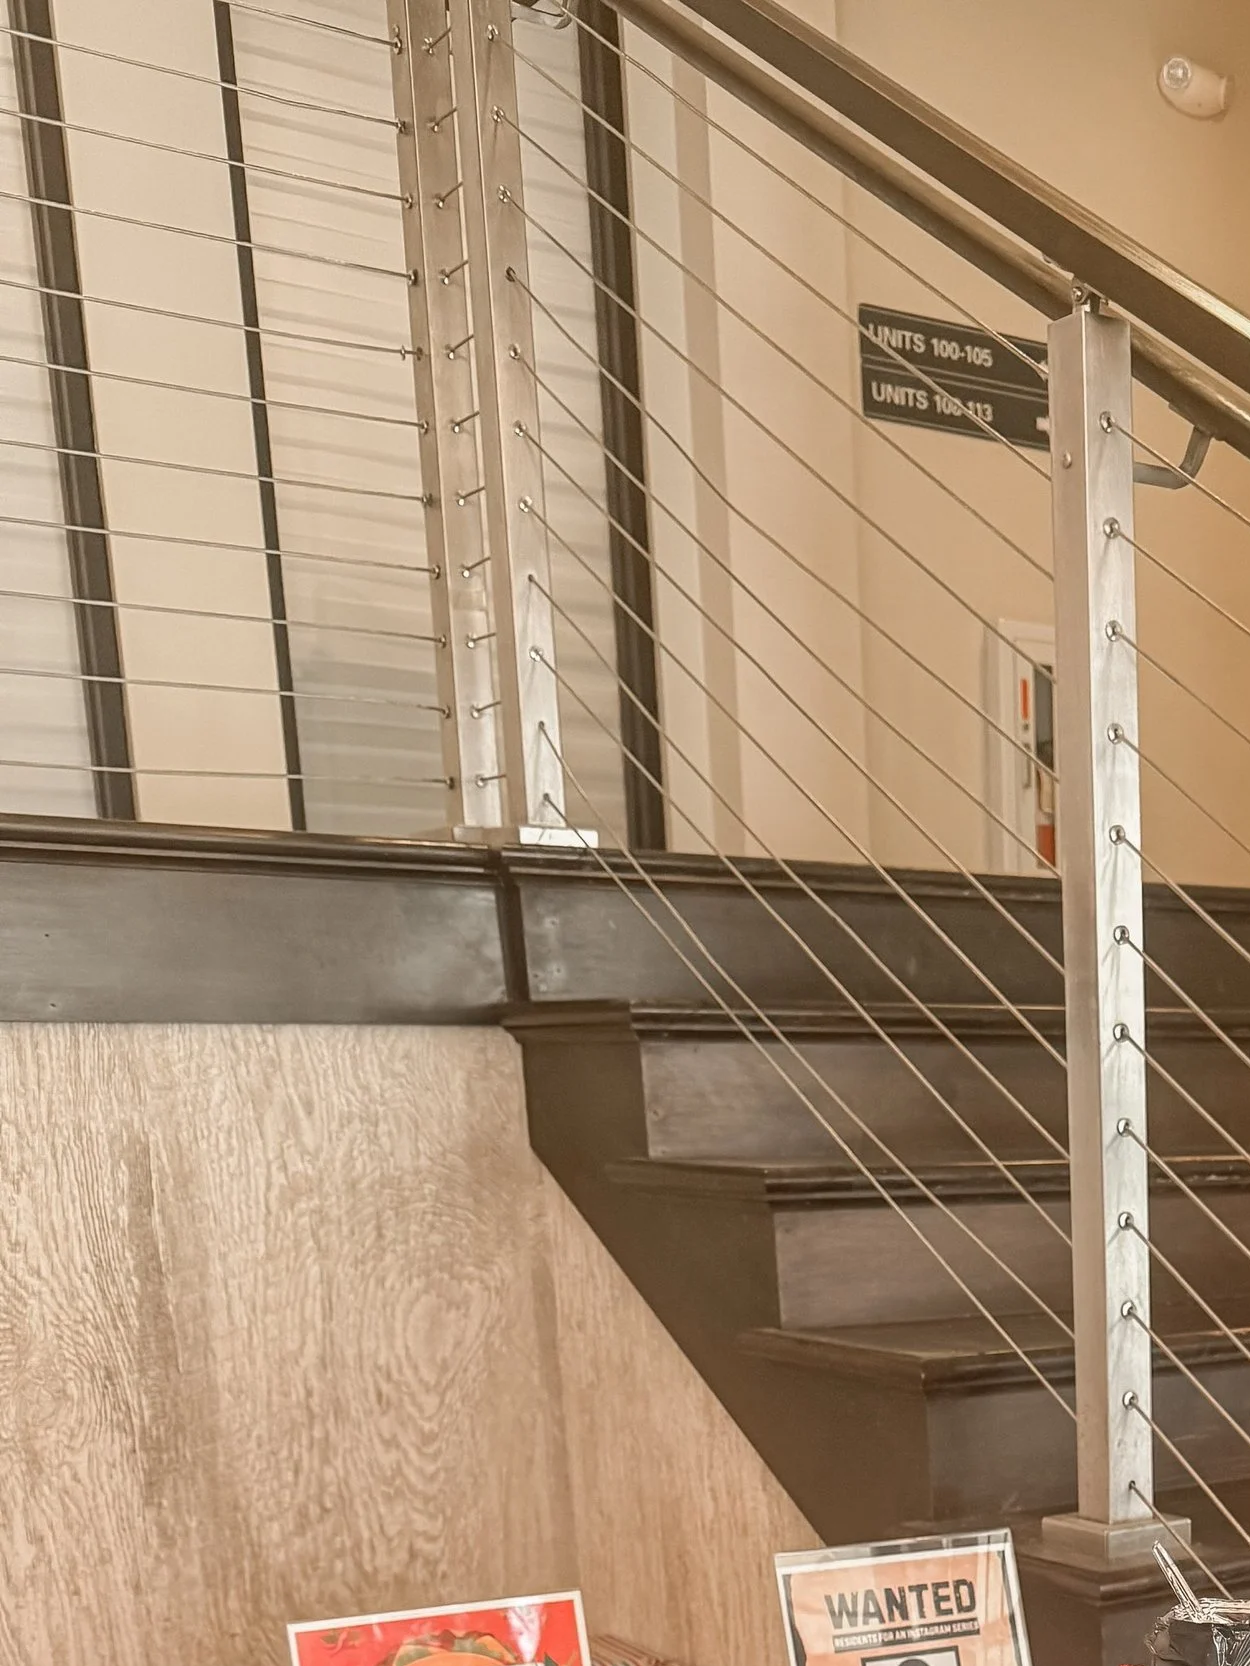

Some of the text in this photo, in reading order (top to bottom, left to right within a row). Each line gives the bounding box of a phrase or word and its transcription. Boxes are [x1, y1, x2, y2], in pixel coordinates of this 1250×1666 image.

[868, 323, 993, 367] UNITS 100-105
[872, 382, 928, 410] UNITS
[824, 1579, 976, 1629] WANTED
[895, 1629, 907, 1640] AN
[907, 1624, 950, 1640] INSTAGRAM
[952, 1621, 980, 1633] SERIES
